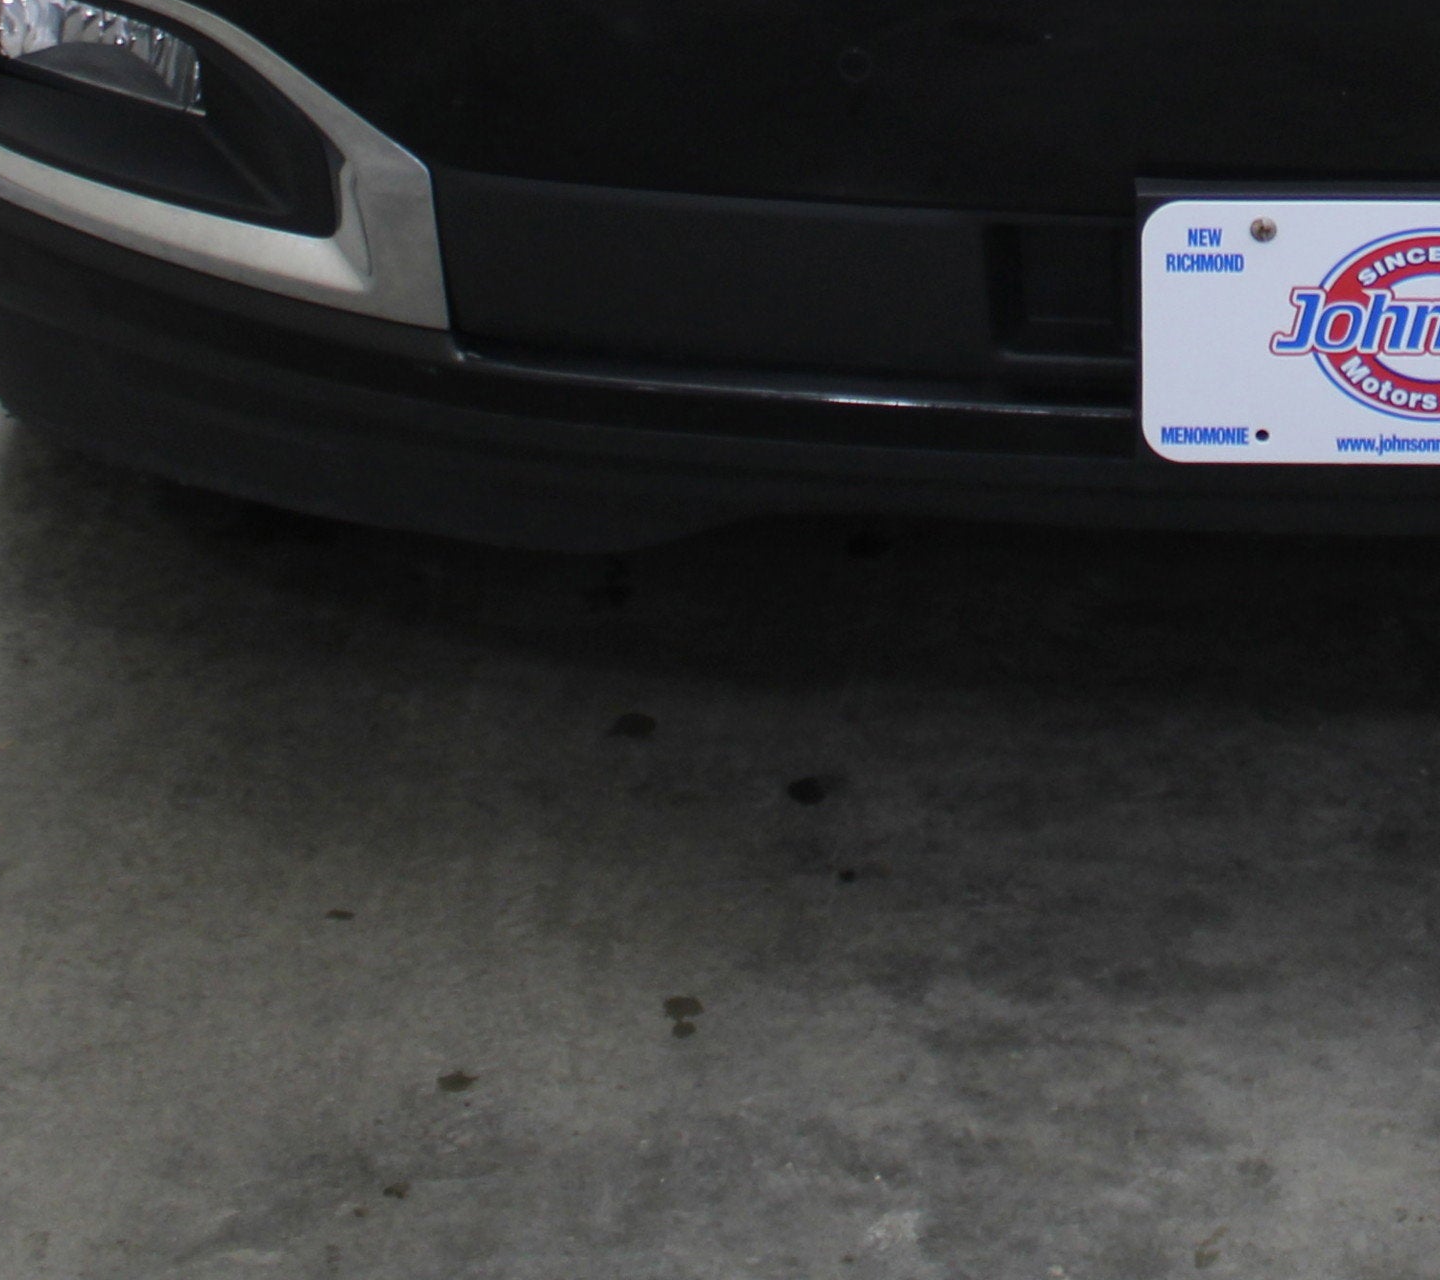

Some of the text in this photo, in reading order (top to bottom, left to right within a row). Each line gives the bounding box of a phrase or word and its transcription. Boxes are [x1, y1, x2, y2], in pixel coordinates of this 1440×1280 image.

[1187, 228, 1222, 247] NEW
[1166, 253, 1245, 272] RICHMOND
[1339, 355, 1437, 410] Motors
[1161, 426, 1249, 445] MENOMONIE
